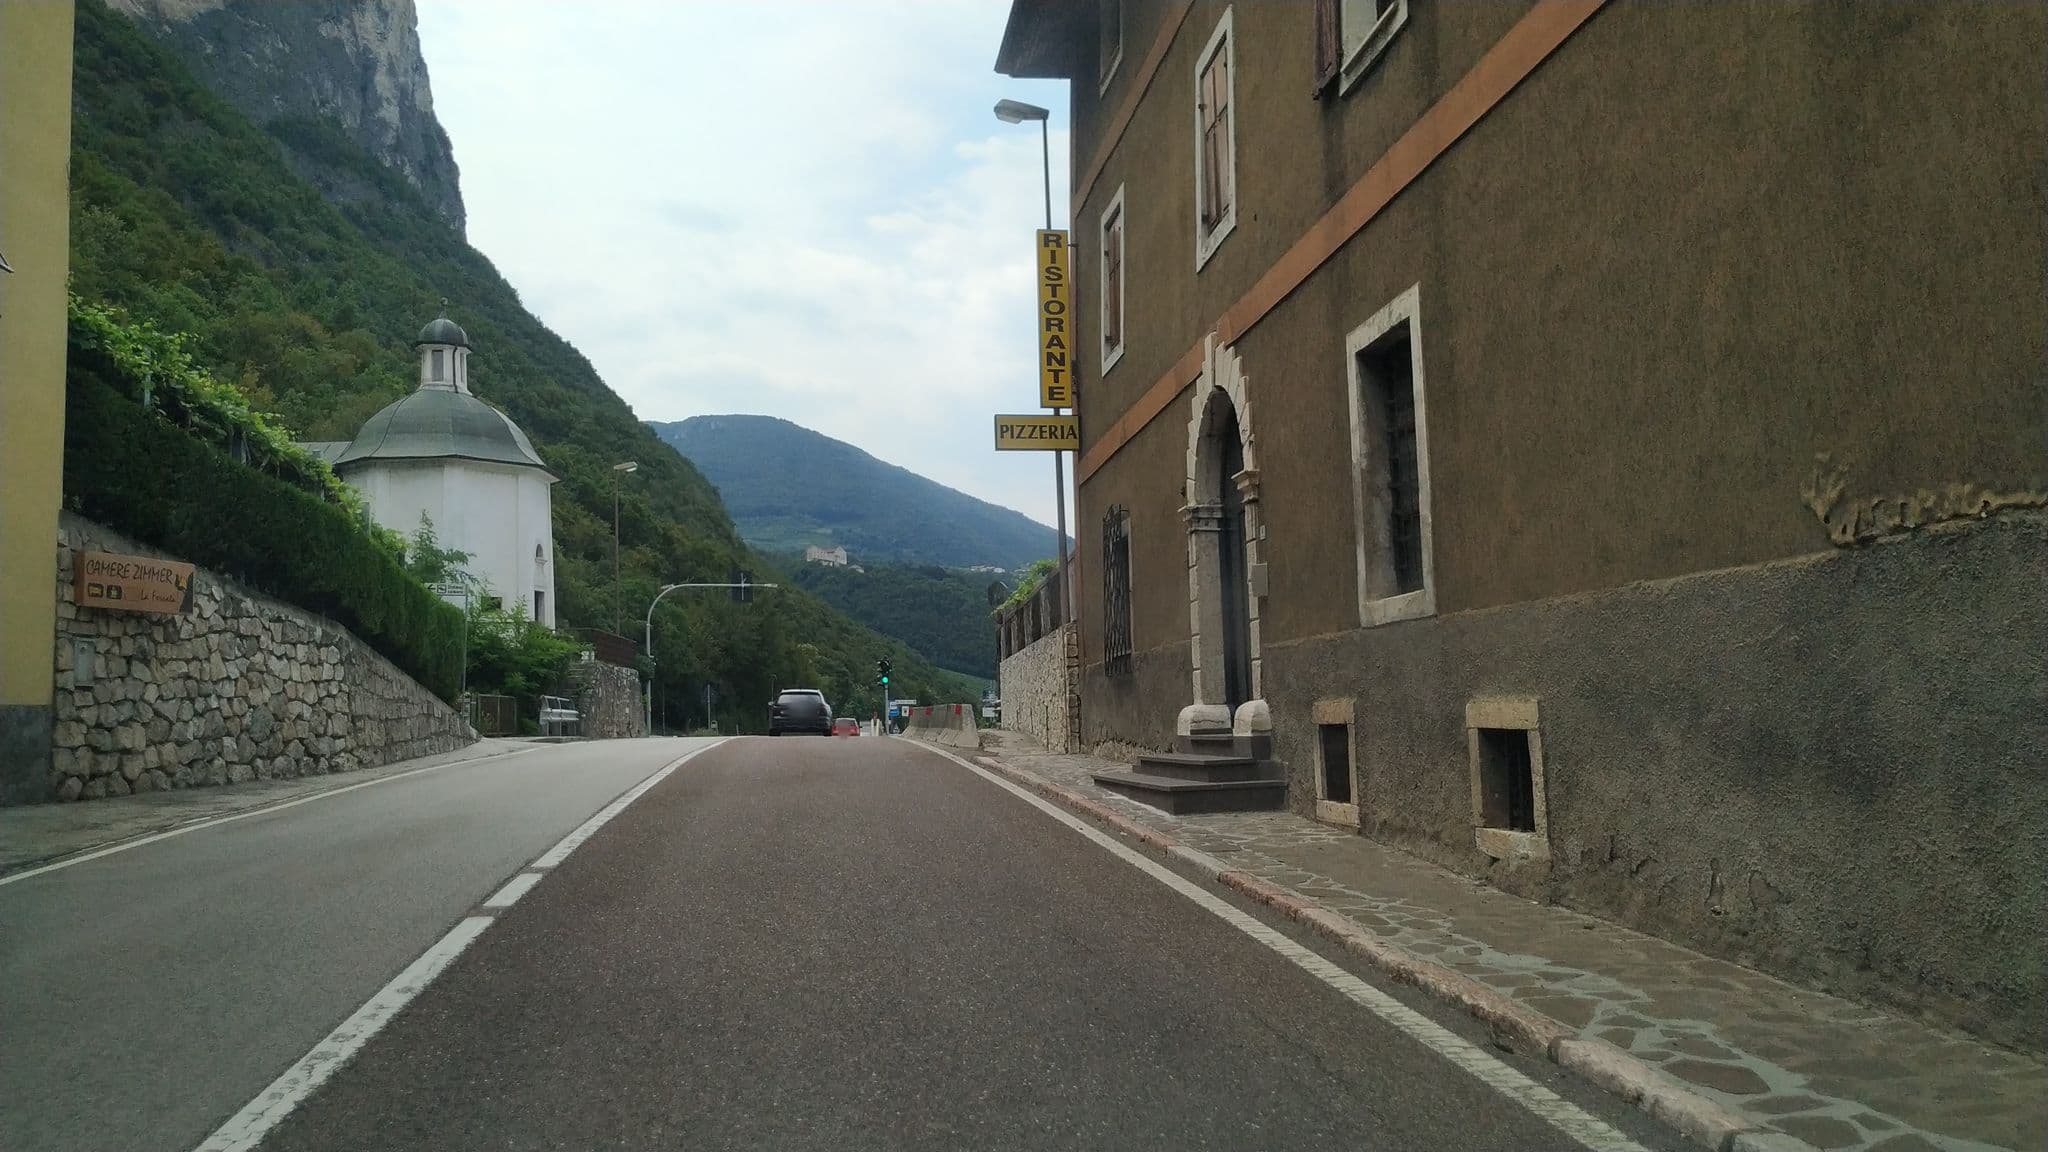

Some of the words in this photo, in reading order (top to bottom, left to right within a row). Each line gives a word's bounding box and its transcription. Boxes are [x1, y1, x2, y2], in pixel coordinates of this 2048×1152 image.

[1043, 233, 1066, 401] RISTORANTE
[1000, 424, 1078, 440] PIZZERIA
[86, 560, 131, 579] CAMERE
[133, 565, 173, 584] ZIMMER
